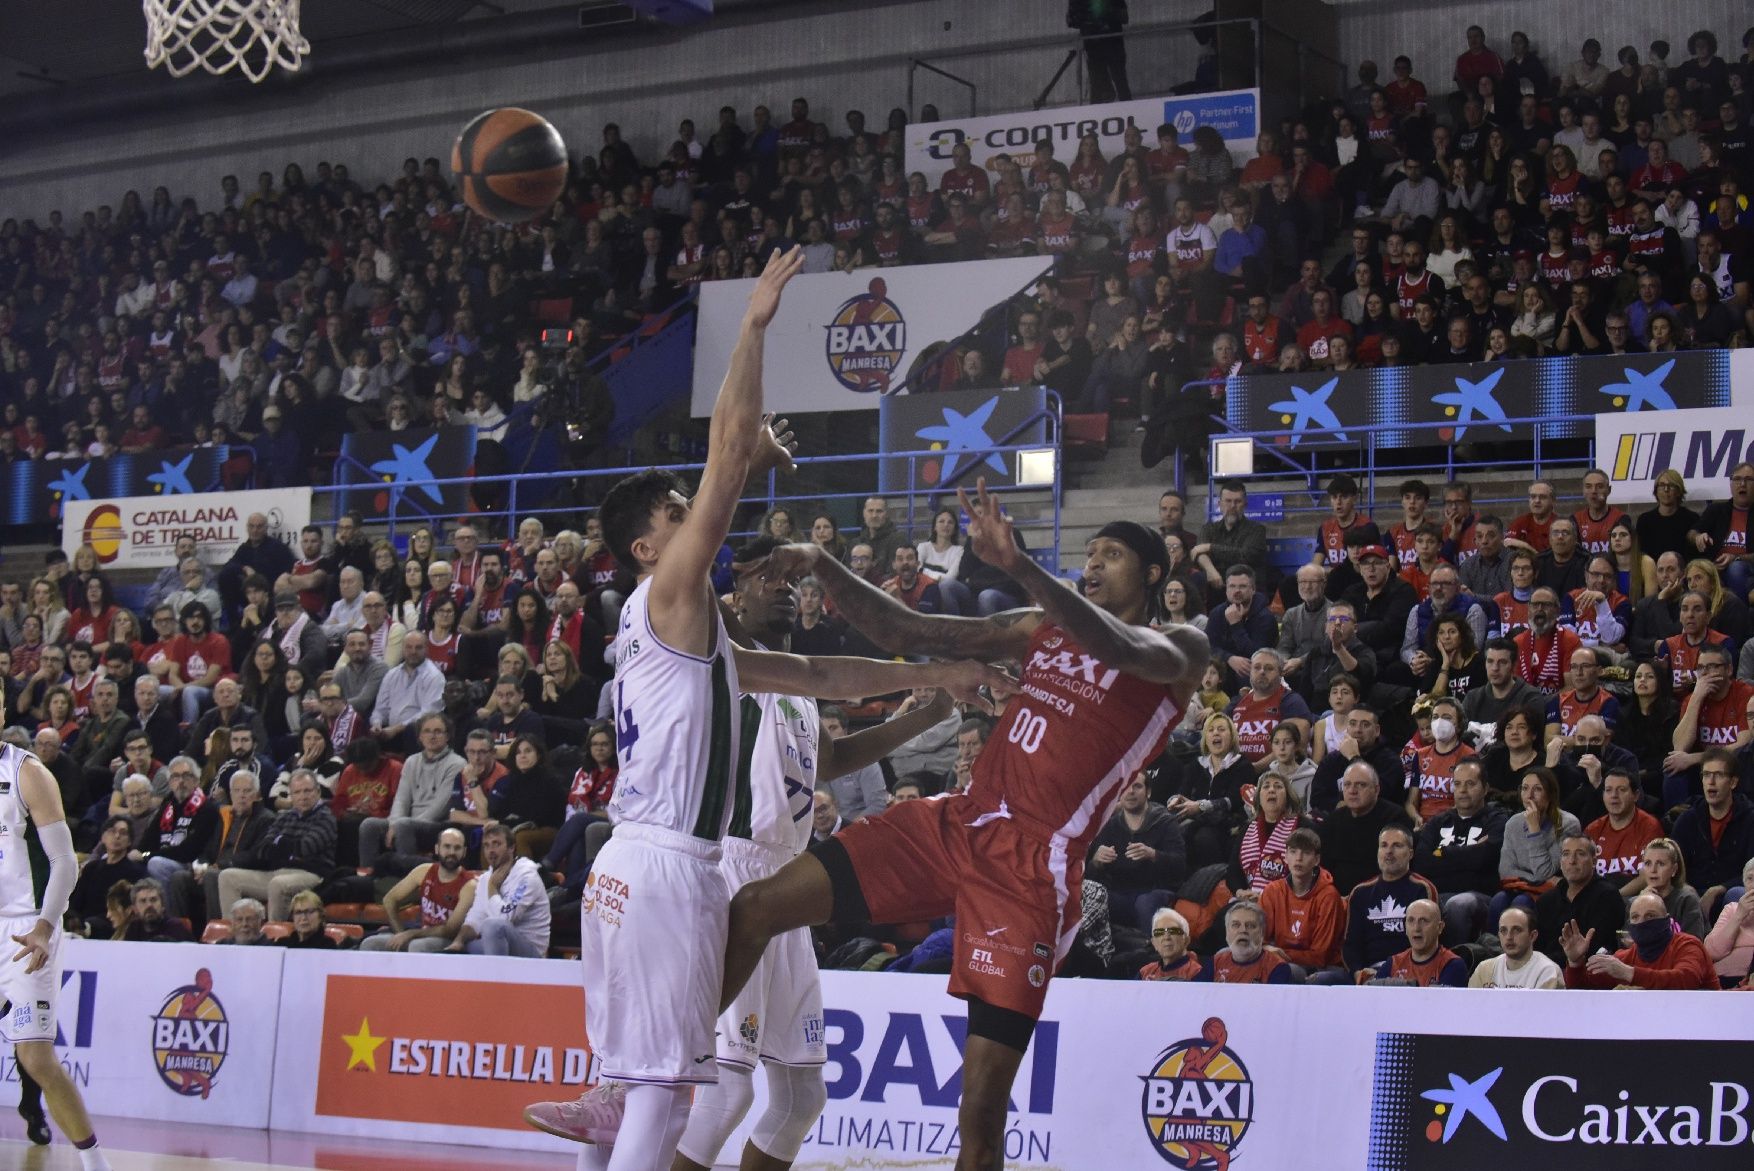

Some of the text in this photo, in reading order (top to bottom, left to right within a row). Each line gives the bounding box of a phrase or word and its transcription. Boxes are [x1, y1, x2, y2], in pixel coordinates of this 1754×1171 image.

[829, 322, 906, 354] BAXI
[842, 355, 892, 374] MANRESA
[131, 506, 240, 527] CATALANA
[131, 529, 156, 546] DE
[1008, 707, 1048, 754] 00
[1594, 858, 1646, 878] BAX
[604, 894, 626, 915] SOL
[971, 948, 994, 965] ETL
[968, 961, 1007, 978] GLOBAL
[154, 1018, 228, 1053] BAXI
[165, 1055, 214, 1073] MANRESA
[389, 1037, 603, 1088] ESTRELLA DA
[1147, 1080, 1251, 1120] BAXI
[1521, 1074, 1754, 1146] CaixaB
[1163, 1124, 1231, 1145] MANRESA
